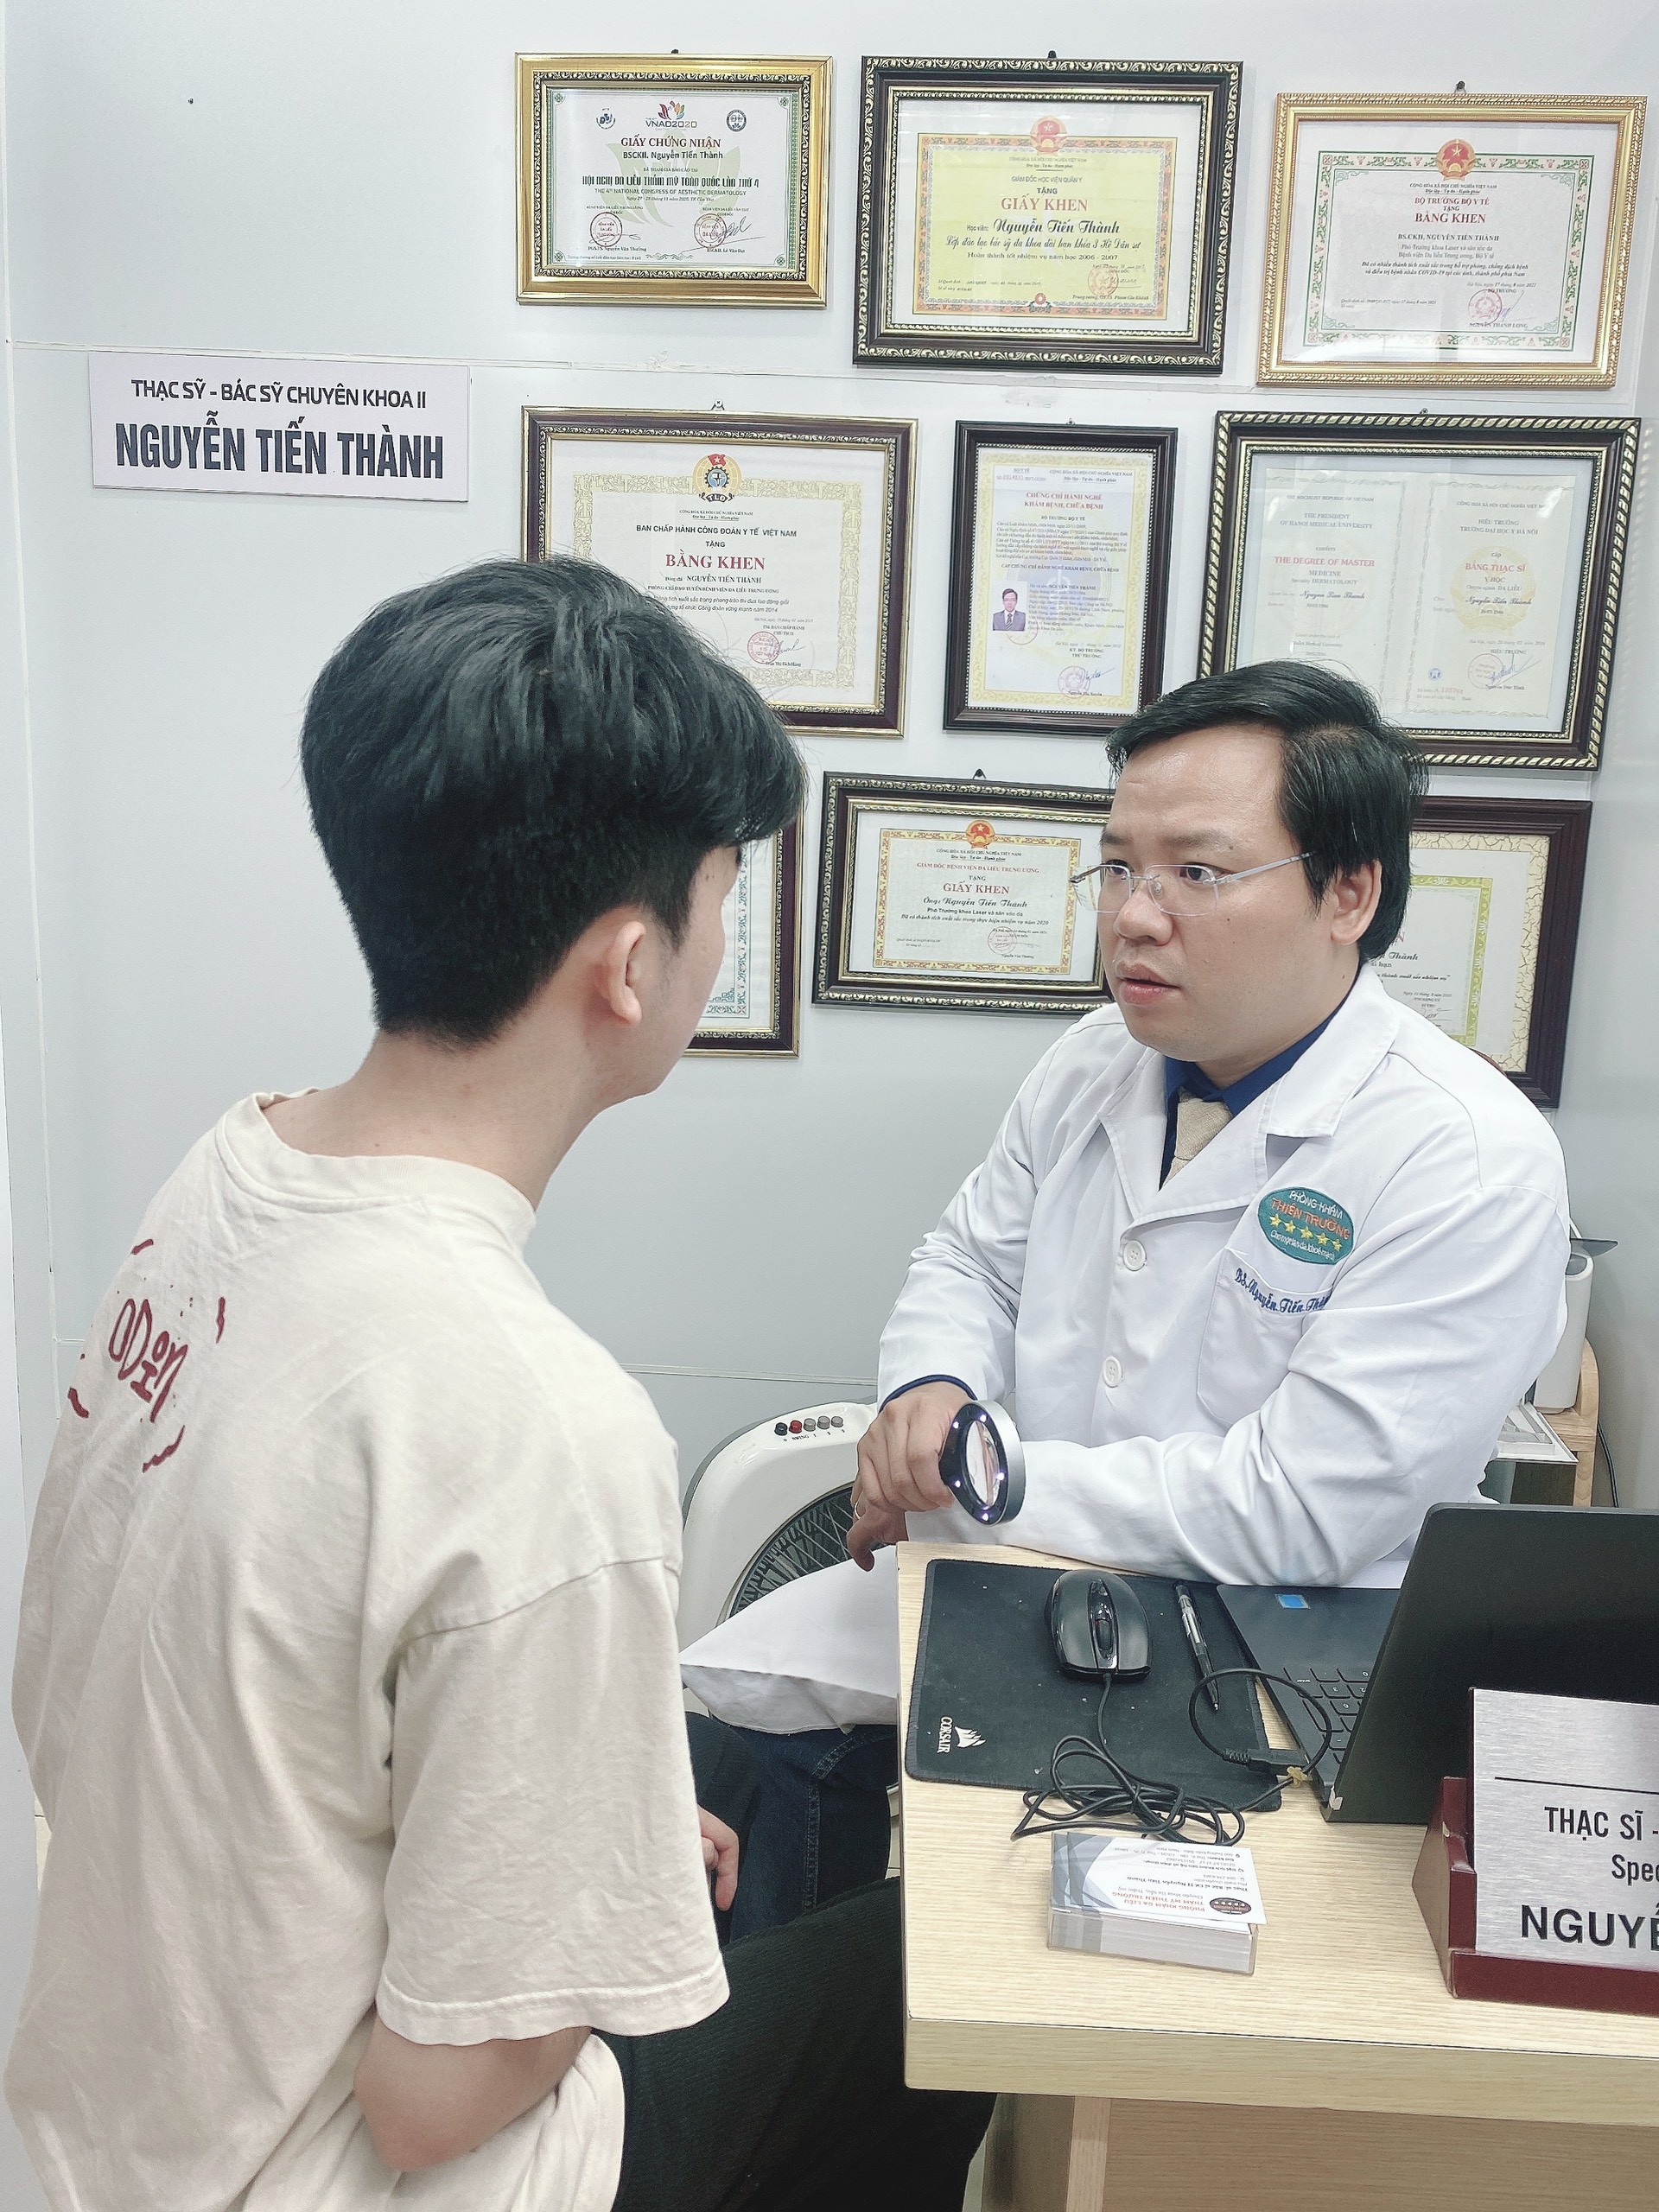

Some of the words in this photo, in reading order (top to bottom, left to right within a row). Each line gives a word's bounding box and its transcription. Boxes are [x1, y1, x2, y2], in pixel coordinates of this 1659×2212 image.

[645, 120, 697, 129] VNAD2020
[621, 134, 646, 146] GIẤY
[649, 136, 686, 147] CHỨNG
[690, 137, 721, 149] NHẬN
[652, 149, 679, 160] Nguyễn
[1037, 187, 1058, 195] TẶNG
[1001, 193, 1039, 210] GIẤY
[1045, 199, 1087, 211] KHEN
[1427, 196, 1459, 205] TRƯỞNG
[1452, 213, 1485, 223] KHEN
[994, 219, 1042, 235] Nguyễn
[1047, 219, 1073, 232] Tiến
[1078, 220, 1120, 233] Thành
[131, 379, 179, 401] THẠC
[182, 378, 206, 399] SỸ
[221, 378, 256, 402] BÁC
[260, 382, 283, 403] SỸ
[287, 383, 358, 405] CHUYÊN
[363, 390, 413, 408] KHOA
[417, 391, 426, 408] II
[116, 410, 245, 471] NGUYỄN
[256, 416, 327, 474] TIẾN
[337, 424, 442, 479] THÀNH
[653, 524, 673, 532] CHẤP
[676, 524, 696, 533] HÀNH
[721, 526, 741, 535] ĐOÀN
[763, 528, 779, 537] VIỆT
[666, 550, 712, 568] BẰNG
[717, 556, 765, 569] KHEN
[1293, 557, 1325, 566] DEGREE
[1491, 564, 1515, 573] THẠC
[944, 880, 972, 893] GIẤY
[976, 885, 1009, 894] KHEN
[943, 897, 975, 906] Nguyễn
[1289, 1191, 1317, 1210] PHÒNG
[1319, 1203, 1343, 1220] KHÁM
[1271, 1198, 1301, 1220] THIÊN
[1305, 1211, 1350, 1241] TRƯỜNG
[937, 1716, 952, 1753] CORSAIR
[1544, 1807, 1608, 1840] THẠC
[1620, 1810, 1643, 1840] SĨ
